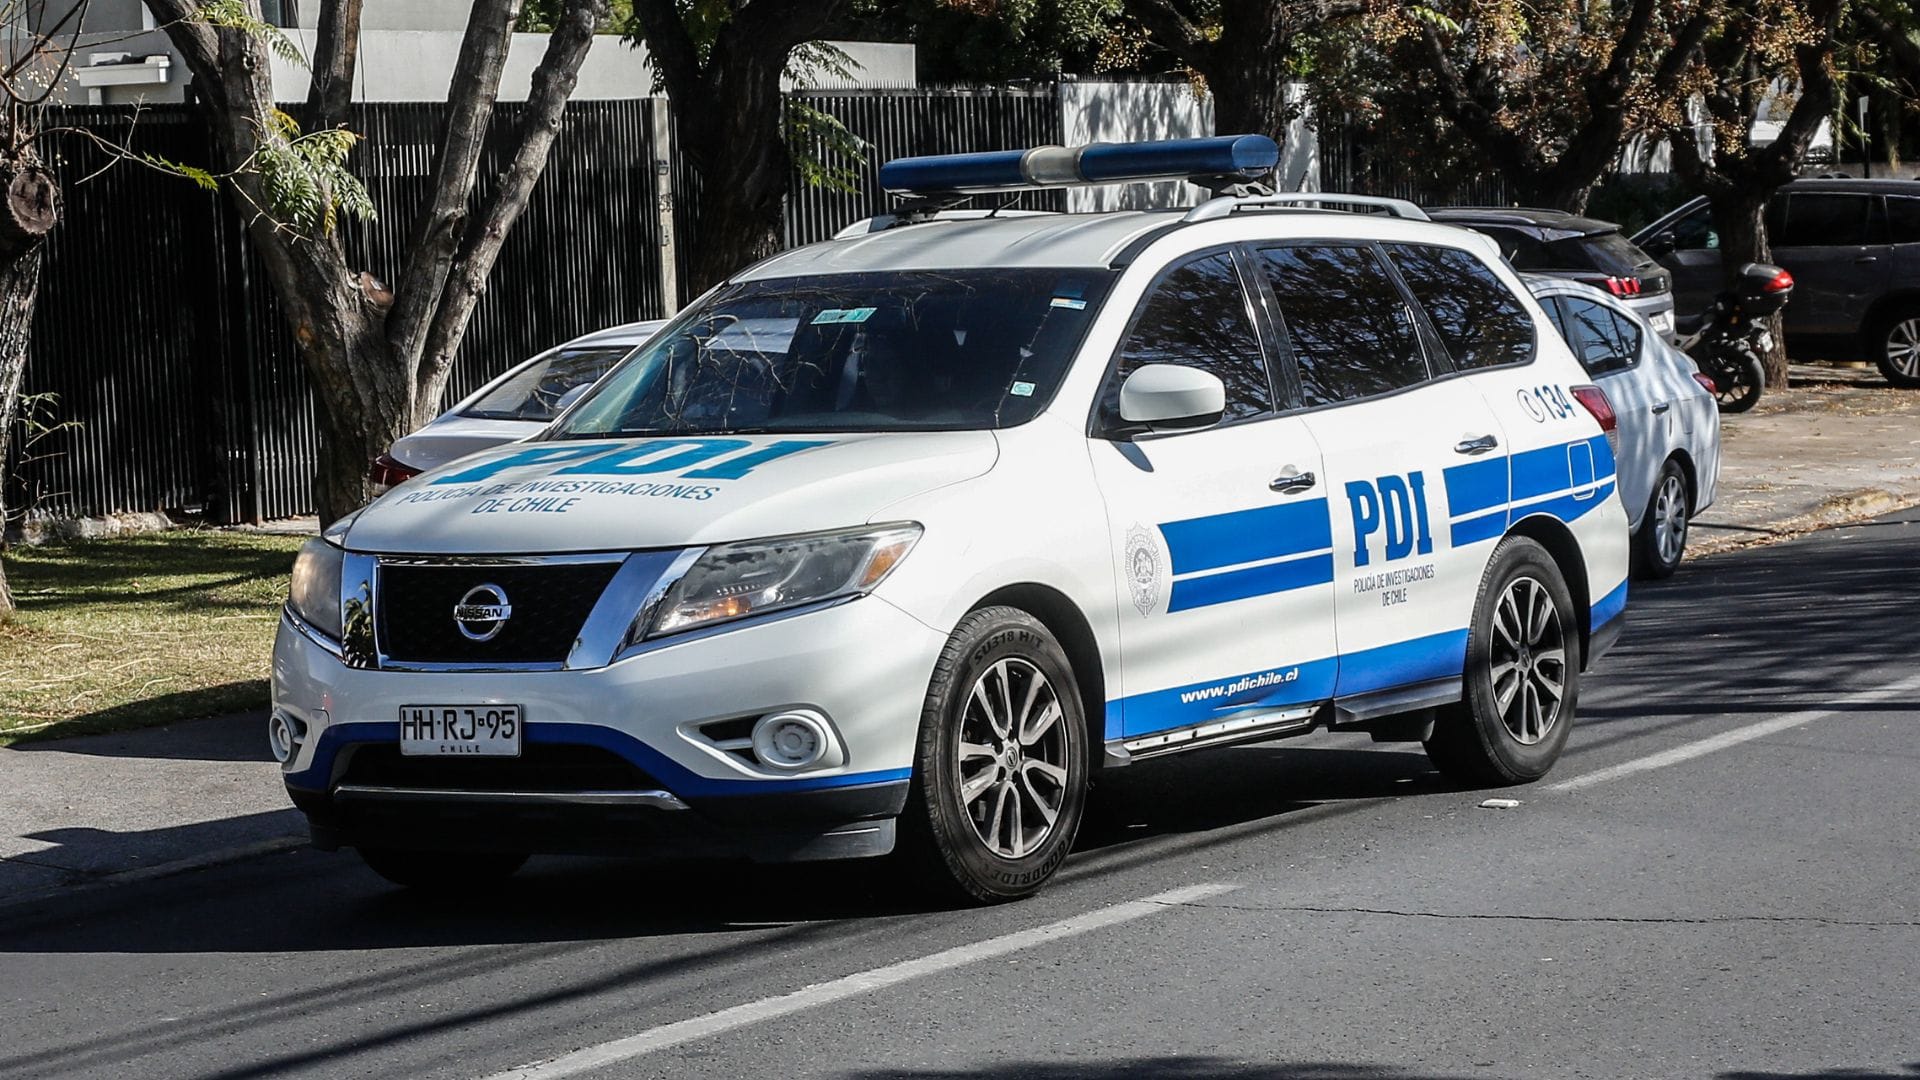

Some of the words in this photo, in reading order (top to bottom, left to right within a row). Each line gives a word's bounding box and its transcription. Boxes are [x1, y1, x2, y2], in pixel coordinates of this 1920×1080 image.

[1534, 384, 1576, 420] 134
[427, 439, 839, 485] PDI
[480, 482, 521, 496] DE
[514, 480, 721, 501] INVESTIGACIONES
[471, 497, 513, 514] DE
[507, 497, 582, 513] CHILE
[1344, 470, 1433, 568] PDI
[1376, 573, 1385, 589] DE
[1385, 563, 1435, 587] INVESTIGACIONES
[1382, 591, 1391, 607] DE
[1391, 587, 1408, 605] CHILE
[454, 607, 503, 620] NISSAN
[974, 630, 1015, 666] SU318
[1180, 667, 1299, 704] www.pdichile.cl
[440, 745, 480, 753] CHILE
